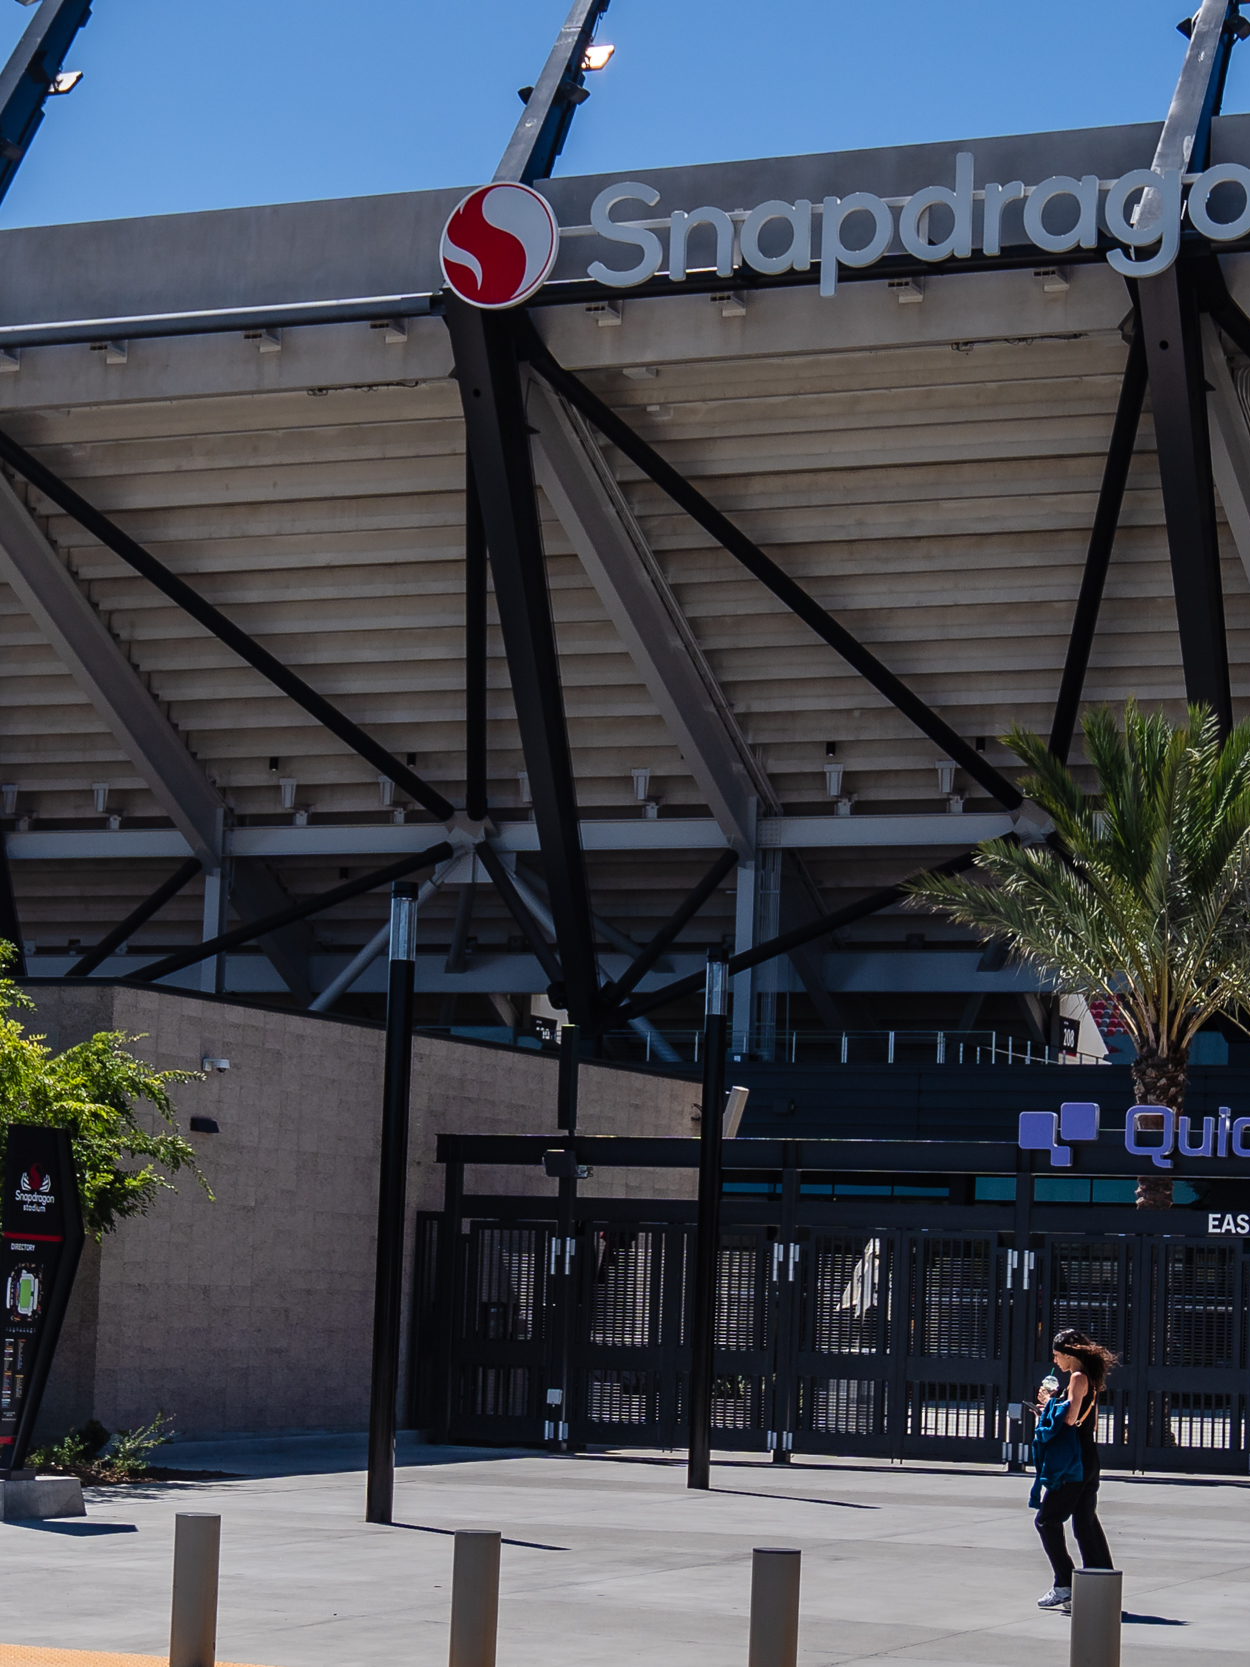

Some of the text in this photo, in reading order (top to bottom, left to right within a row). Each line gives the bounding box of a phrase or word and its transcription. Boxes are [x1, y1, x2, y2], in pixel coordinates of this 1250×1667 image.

[1063, 1028, 1075, 1048] 208
[15, 1189, 55, 1205] Snapdragon
[23, 1203, 46, 1213] stadium
[10, 1242, 36, 1252] DIRECTORY
